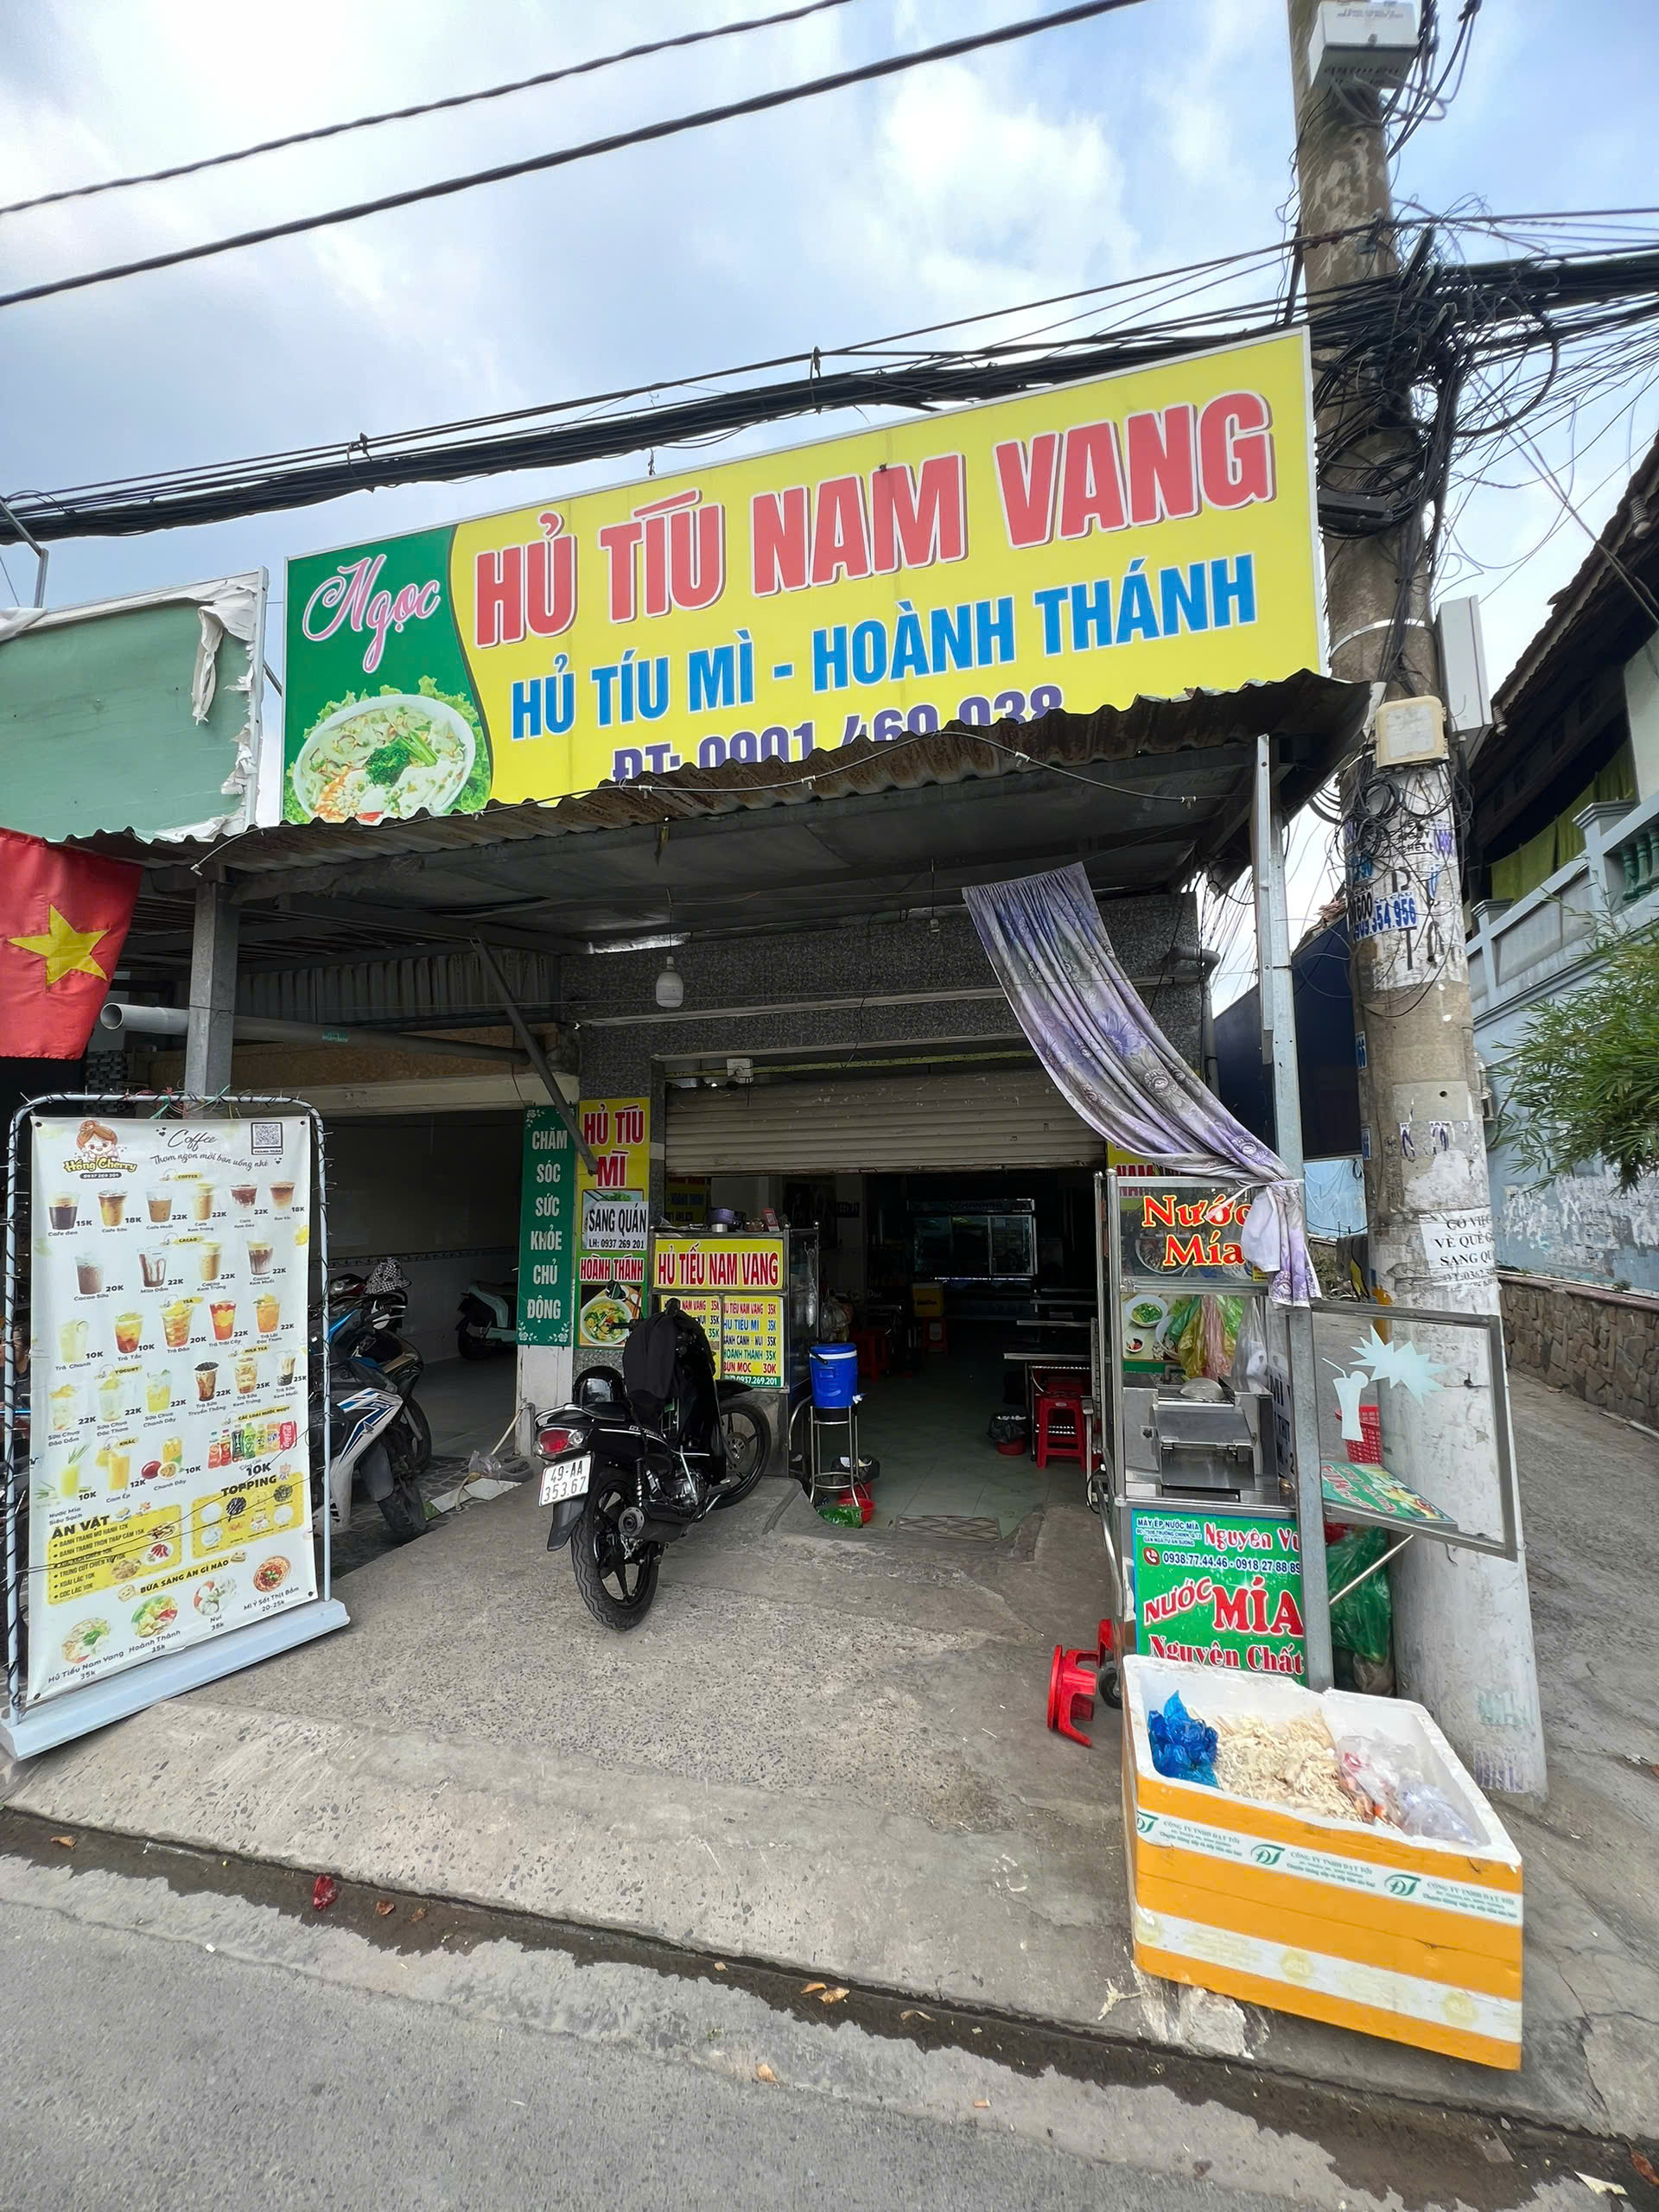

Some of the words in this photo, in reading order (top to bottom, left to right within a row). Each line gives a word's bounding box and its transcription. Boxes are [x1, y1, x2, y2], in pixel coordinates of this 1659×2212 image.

[475, 512, 578, 648] HỦ
[598, 488, 725, 624] TÍU
[749, 452, 969, 597] NAM
[994, 391, 1278, 549] VANG
[302, 554, 441, 674] Ngọc
[512, 653, 575, 742] HỦ
[591, 648, 670, 728] TÍU
[688, 629, 754, 715] MÌ
[811, 601, 1016, 694] HOÀNH
[1033, 552, 1256, 657] THÁNH
[583, 1103, 608, 1146] HỦ
[614, 1105, 645, 1145] TÍU
[168, 1128, 217, 1152] Coffee
[532, 1127, 567, 1149] CHĂM
[96, 1157, 138, 1173] Cherry
[177, 1154, 198, 1163] ngon
[596, 1149, 629, 1188] MÌ
[537, 1160, 561, 1183] SÓC
[535, 1193, 560, 1217] SỨC
[1141, 1194, 1251, 1227] Nước
[589, 1209, 615, 1232] SANG
[619, 1202, 646, 1236] QUÁN
[589, 1239, 600, 1248] LH:
[601, 1239, 616, 1249] 0937
[619, 1240, 631, 1249] 269
[632, 1240, 645, 1249] 201
[1163, 1230, 1245, 1266] Mía
[533, 1258, 557, 1285] CHỦ
[580, 1253, 611, 1281] HOÀNH
[613, 1253, 644, 1281] THÁNH
[658, 1244, 674, 1286] HỦ
[678, 1242, 705, 1286] TIẾU
[709, 1252, 740, 1286] NAM
[741, 1252, 779, 1286] VANG
[1440, 1253, 1478, 1267] SANG
[527, 1295, 561, 1323] ĐỘNG
[767, 1337, 776, 1346] 35K
[766, 1351, 776, 1360] 35K
[763, 1363, 776, 1374] 30K
[170, 1399, 187, 1408] 22K
[216, 1389, 232, 1397] 22K
[78, 1416, 96, 1425] 22K
[185, 1465, 201, 1474] 10K
[246, 1462, 271, 1477] 10K
[550, 1460, 582, 1483] 49-AA
[130, 1478, 146, 1488] 12K
[221, 1474, 276, 1497] TOPPING
[543, 1477, 586, 1502] 353.67
[79, 1491, 97, 1501] 10K
[51, 1523, 75, 1539] ĂN
[1205, 1522, 1272, 1552] Nguyên
[1164, 1553, 1227, 1568] 0938.77.44.46
[1236, 1559, 1259, 1571] 0918
[1262, 1560, 1272, 1571] 27
[1276, 1561, 1287, 1573] 88
[140, 1582, 159, 1594] BỮA
[161, 1573, 184, 1587] SÁNG
[1144, 1576, 1212, 1625] NƯỚC
[1211, 1575, 1304, 1637] MÍA
[82, 1658, 102, 1670] Nam
[103, 1650, 124, 1663] Vang
[1246, 1643, 1304, 1674] Chất
